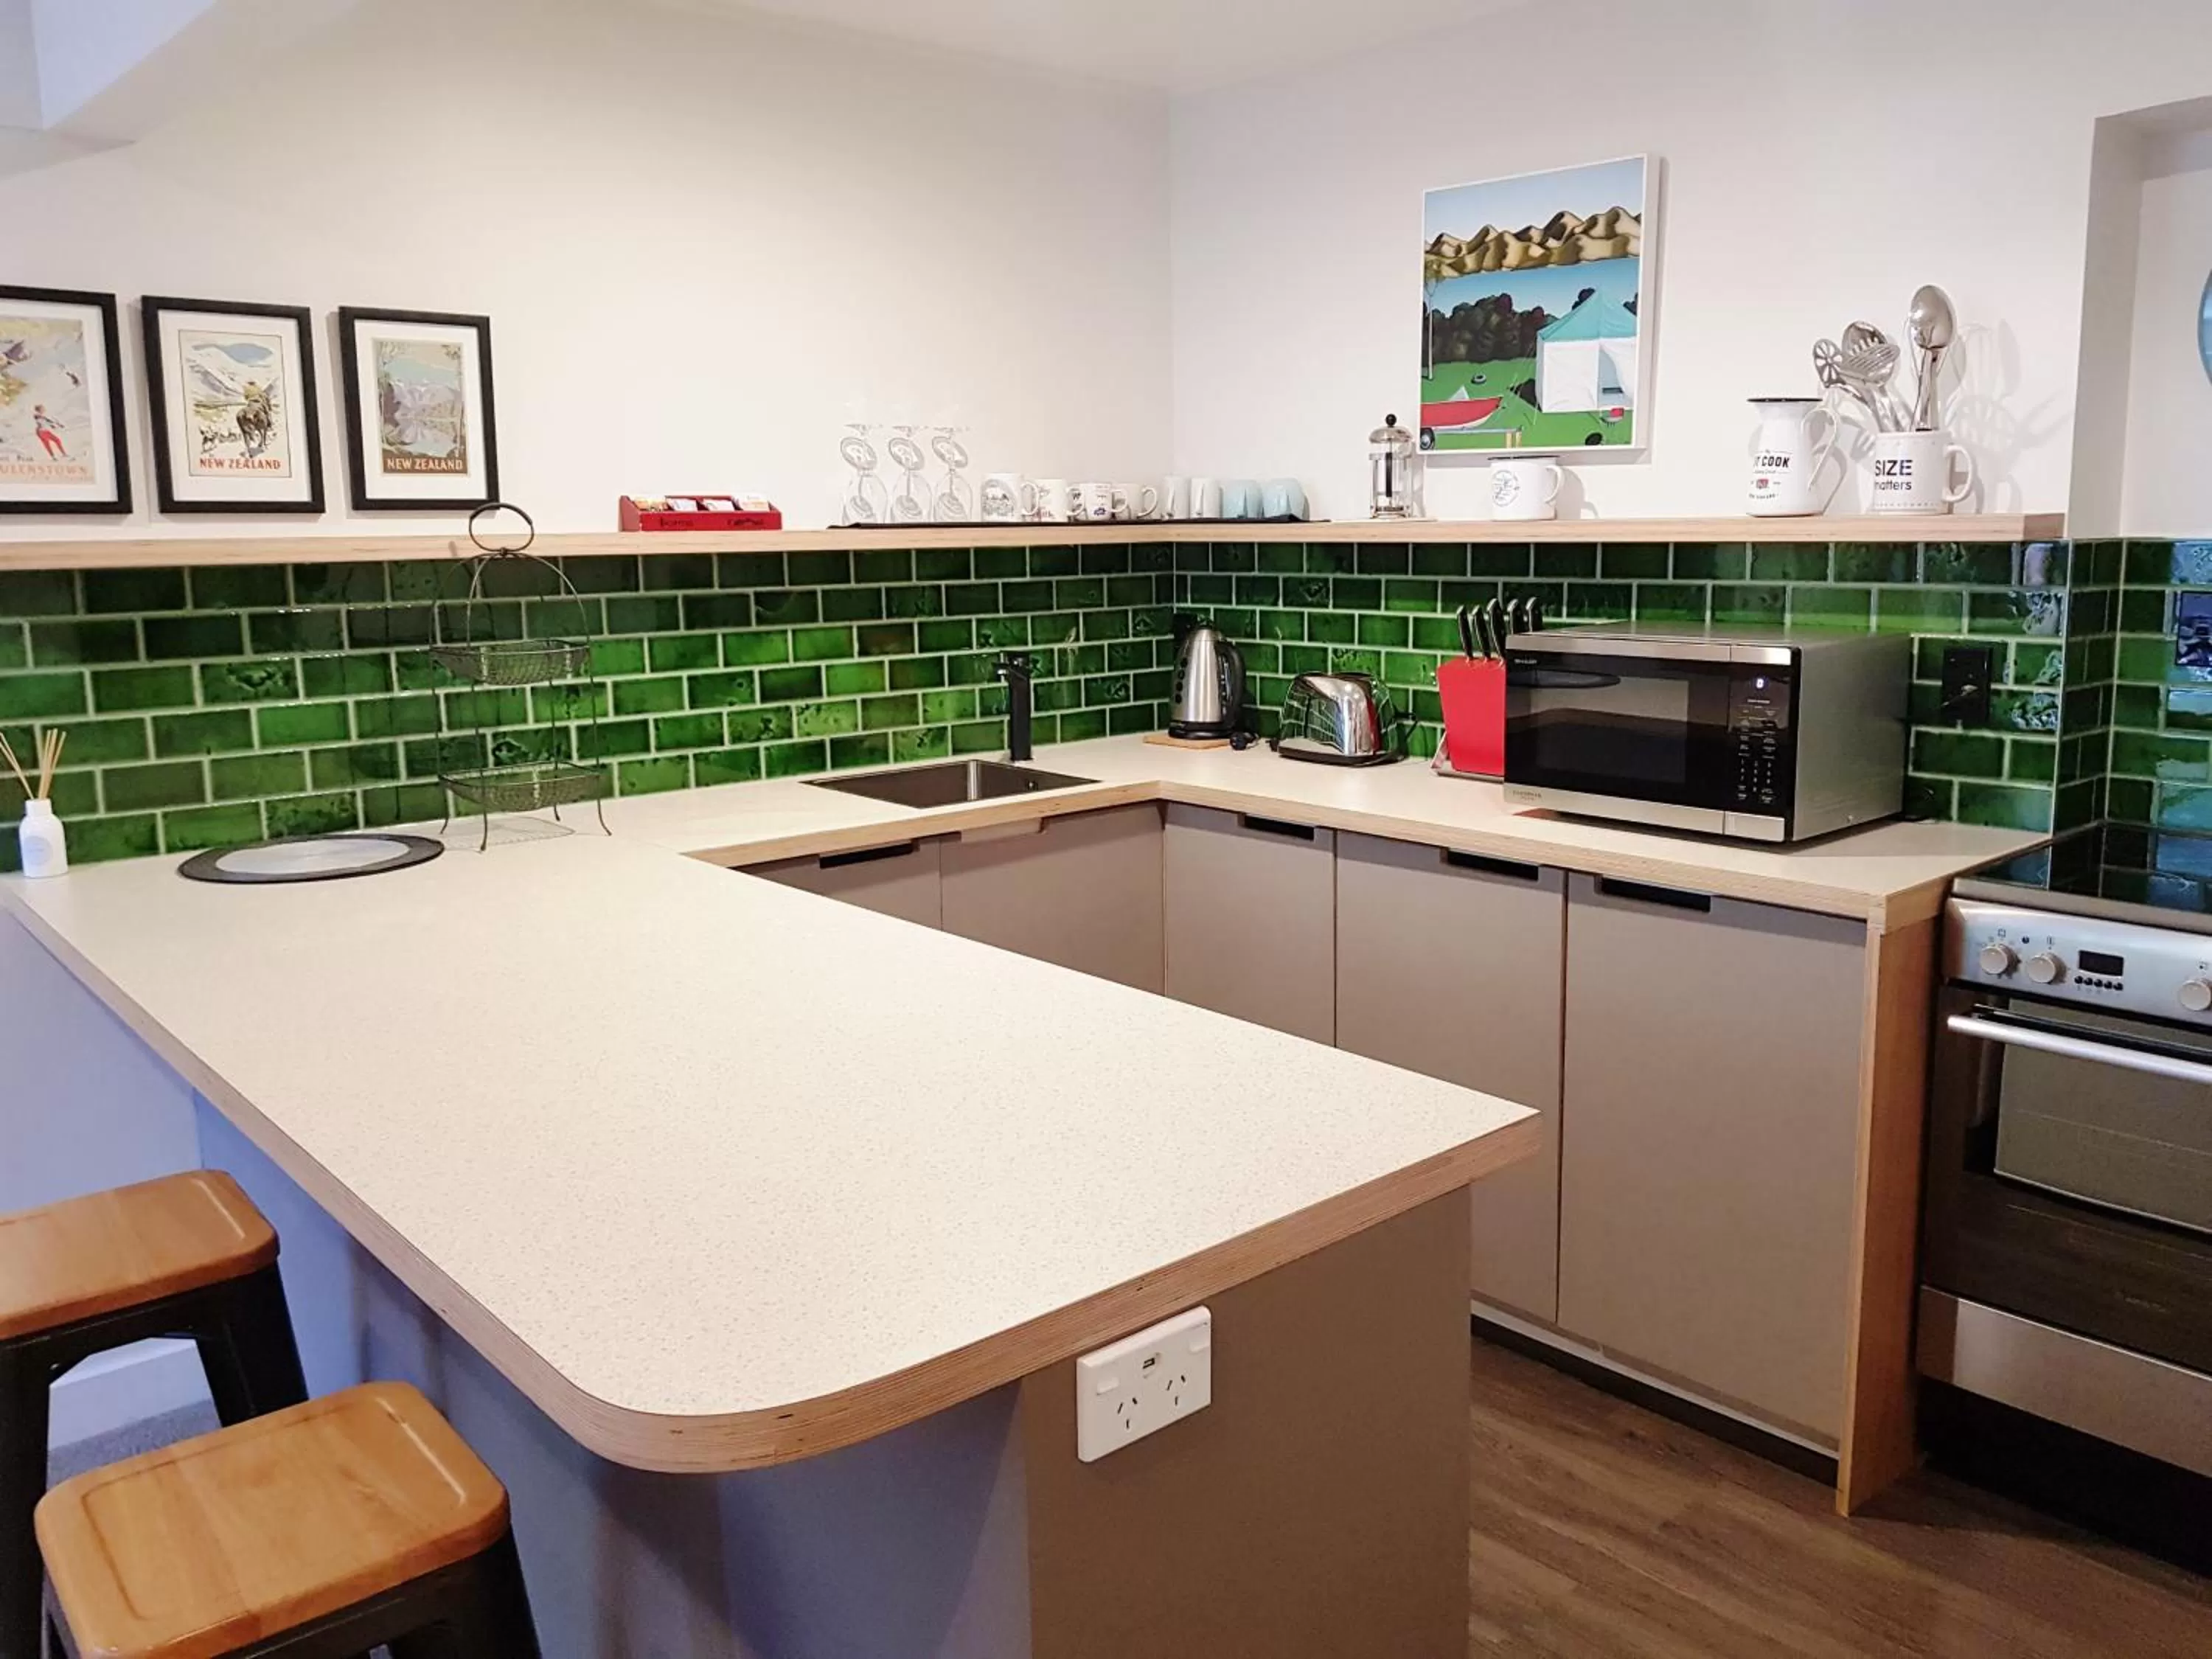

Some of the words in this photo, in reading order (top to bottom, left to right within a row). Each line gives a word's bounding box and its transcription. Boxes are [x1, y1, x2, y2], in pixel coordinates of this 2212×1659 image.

[200, 457, 224, 469] NEW
[228, 458, 281, 470] ZEALAND
[386, 457, 411, 470] NEW
[414, 458, 464, 470] ZEALAND
[1761, 455, 1790, 468] COOK
[1874, 459, 1913, 476] SIZE
